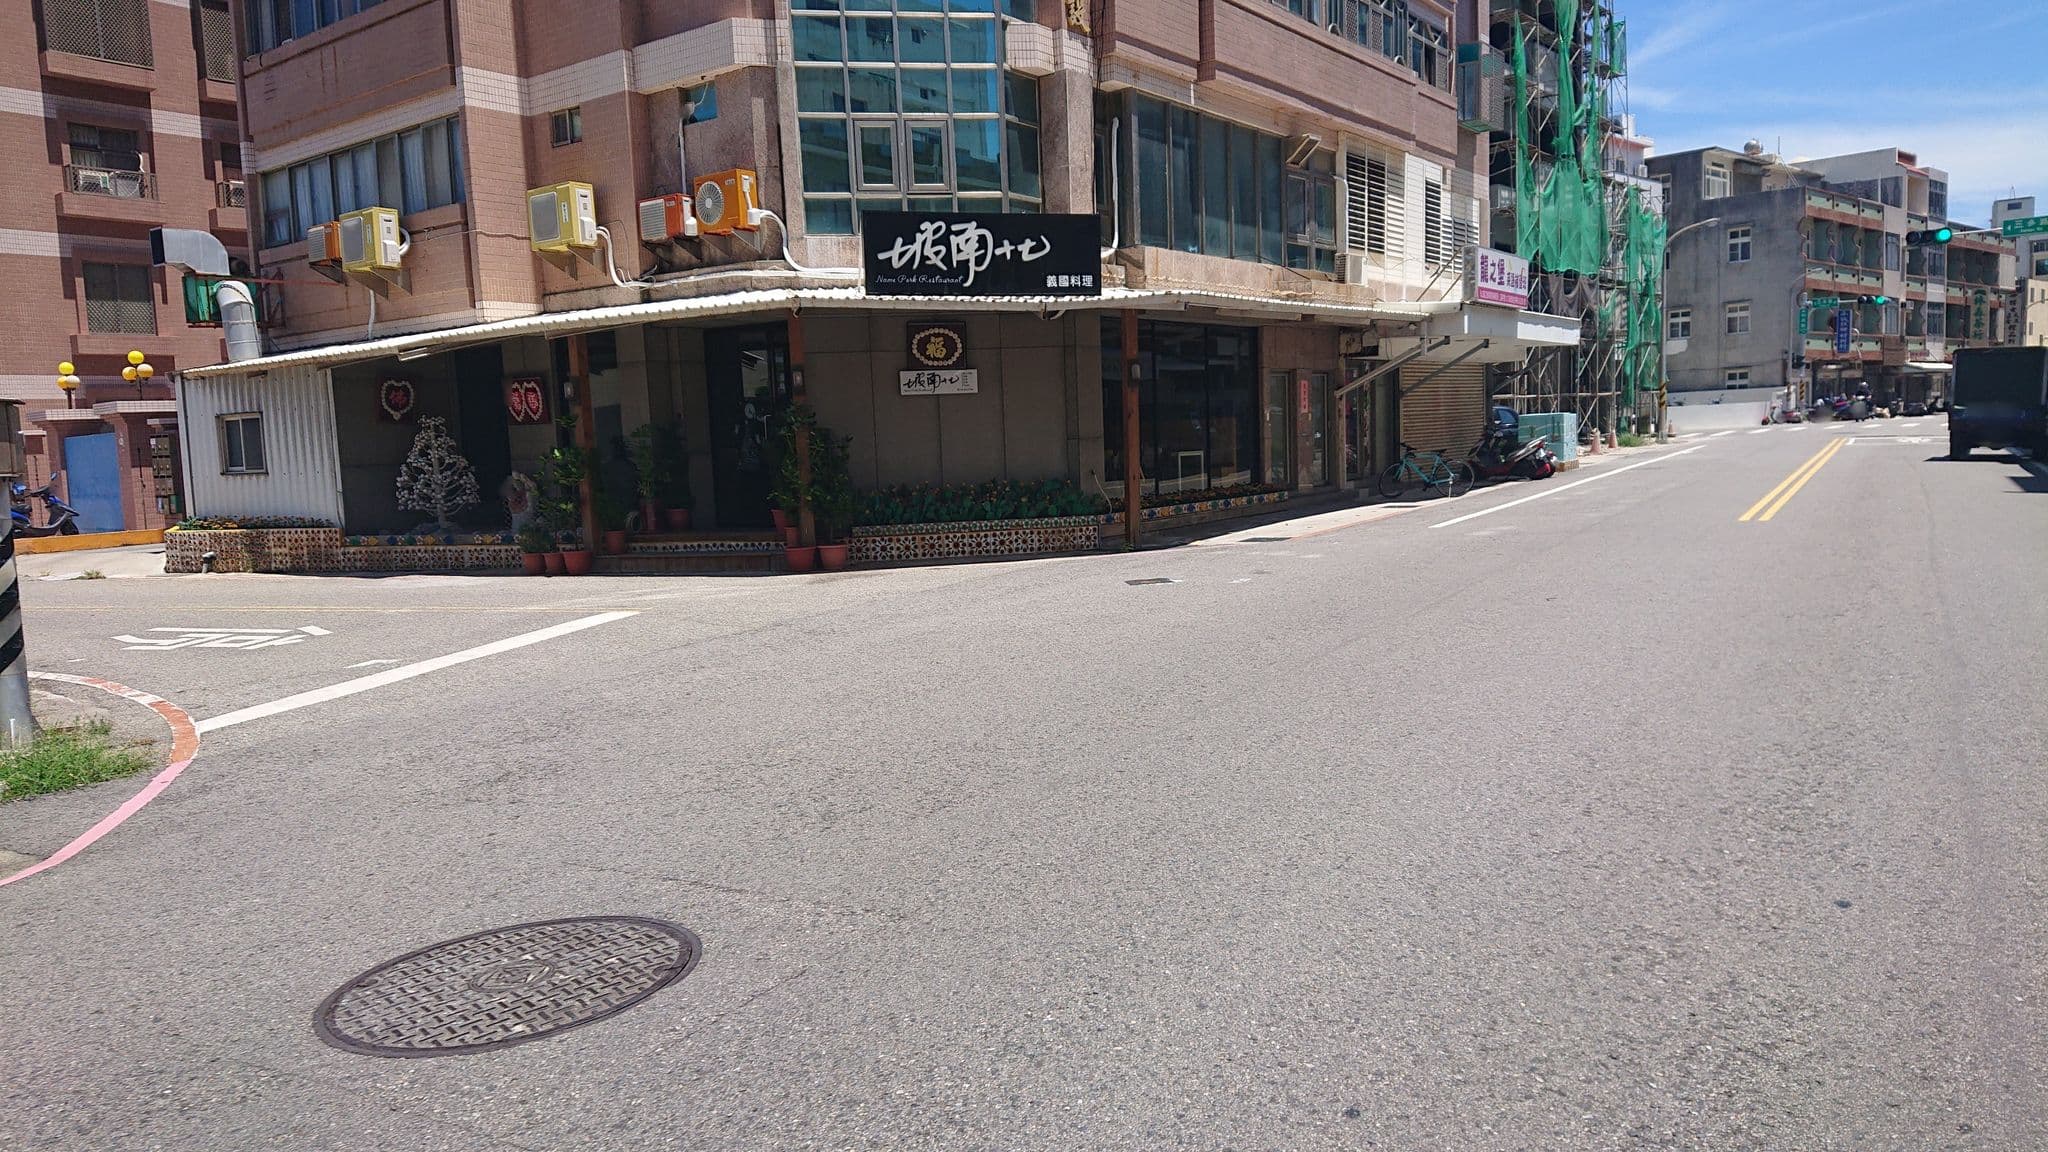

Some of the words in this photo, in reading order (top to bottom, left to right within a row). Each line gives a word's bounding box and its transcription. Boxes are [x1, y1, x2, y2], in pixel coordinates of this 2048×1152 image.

[918, 274, 964, 284] Restaurant
[1046, 275, 1094, 288] 義國料理
